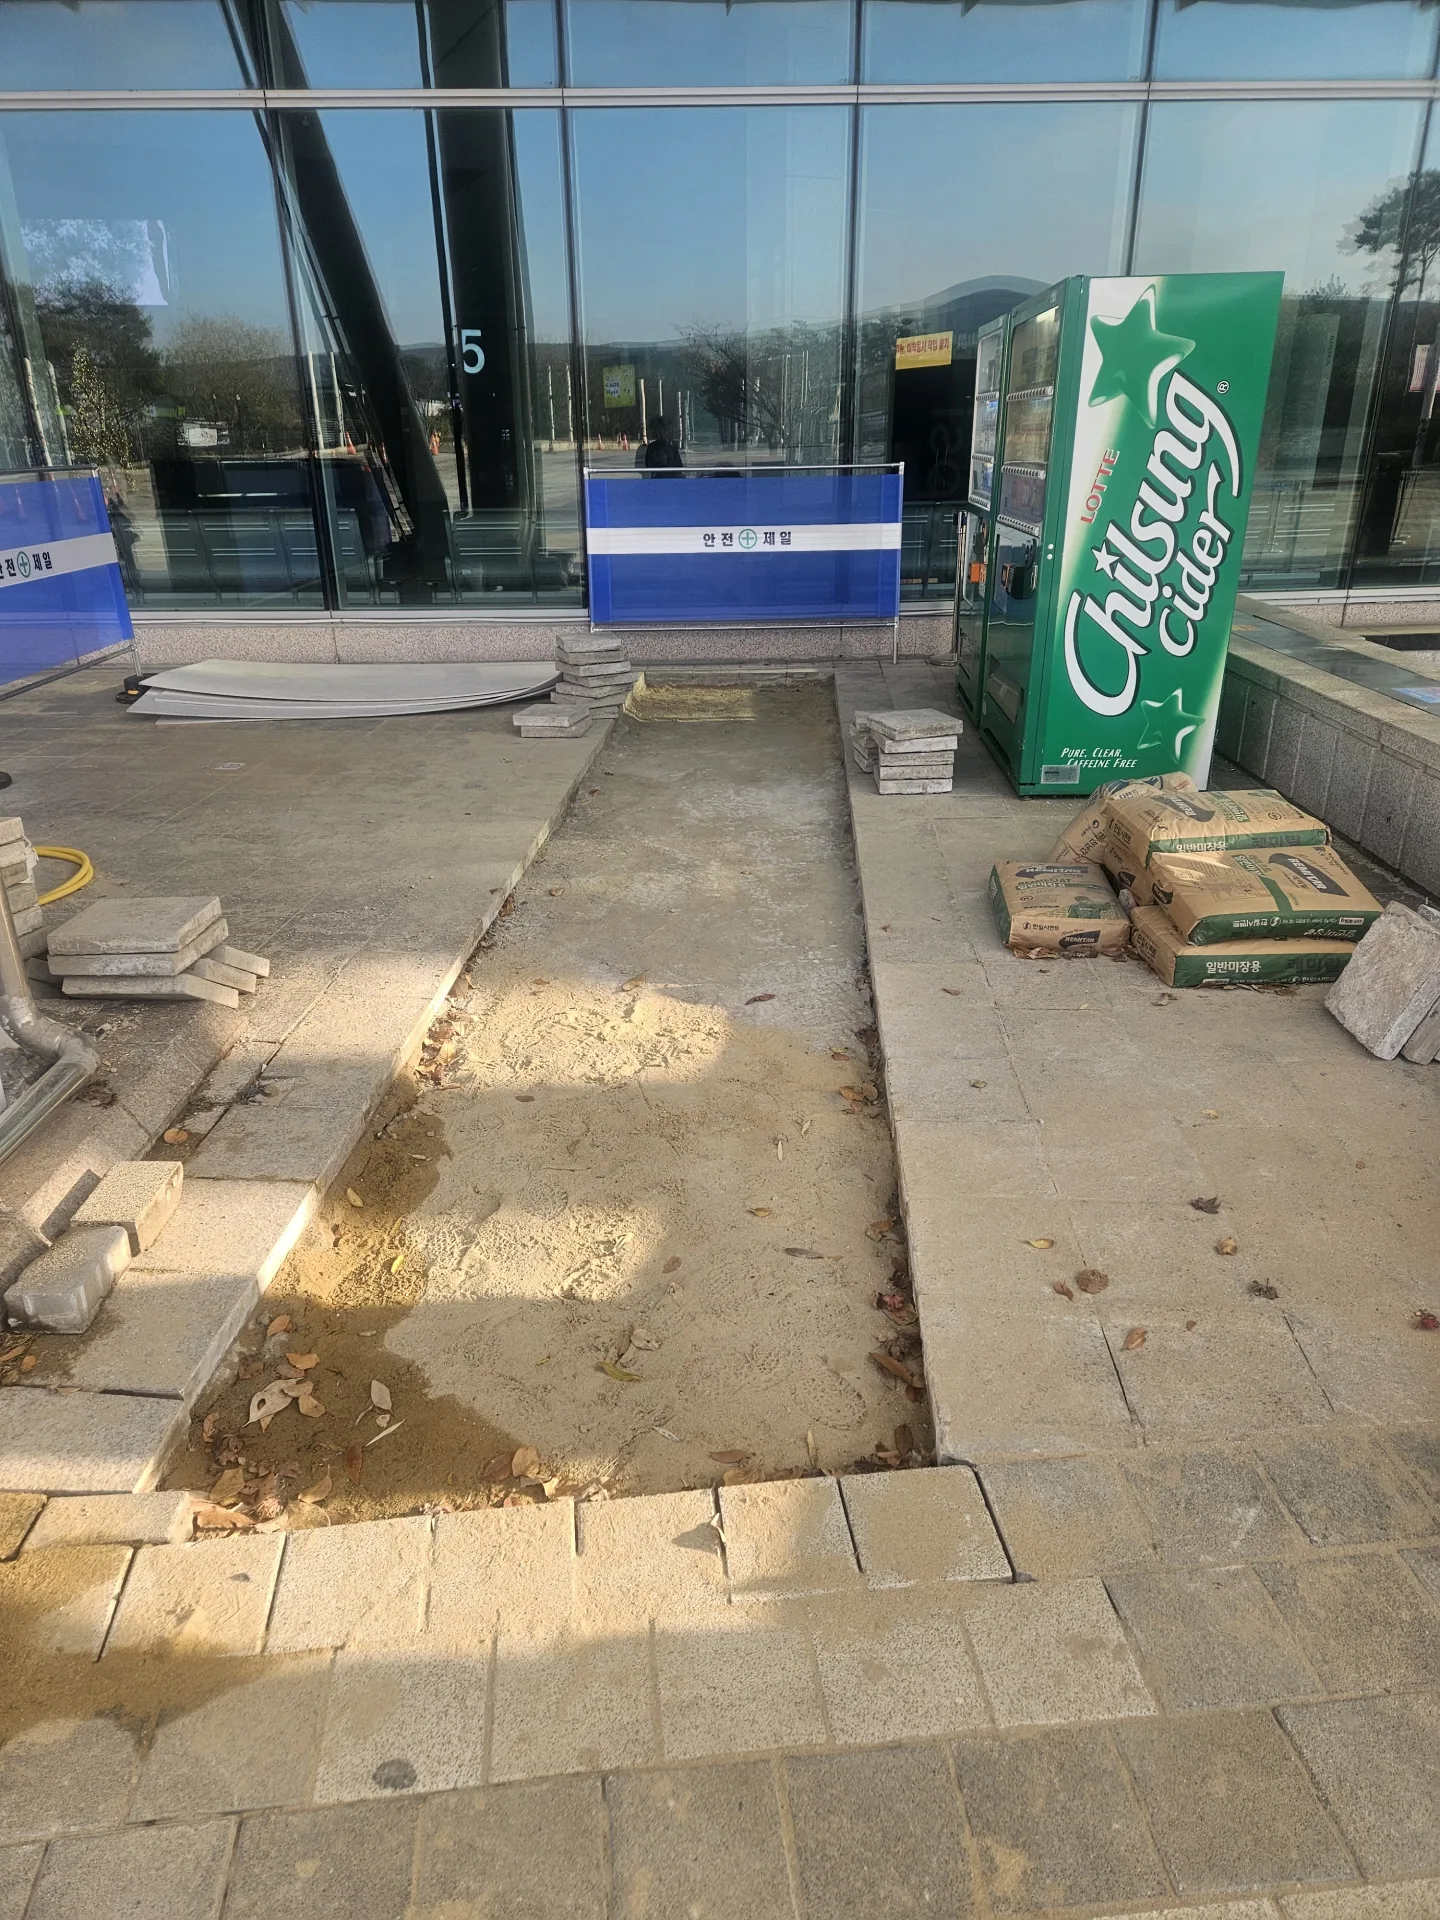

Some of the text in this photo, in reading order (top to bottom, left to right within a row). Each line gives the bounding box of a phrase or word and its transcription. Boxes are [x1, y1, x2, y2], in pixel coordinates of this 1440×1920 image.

[461, 329, 485, 374] 5
[1080, 448, 1120, 524] LOTTE
[703, 531, 792, 547] 안전 제일
[1064, 371, 1240, 716] Chilsung
[32, 551, 53, 571] 제일
[1159, 462, 1231, 657] Cider
[1066, 758, 1138, 768] CAFFEINE FREE
[1032, 923, 1059, 931] 한일시멘트
[1206, 960, 1262, 974] 일반미장용
